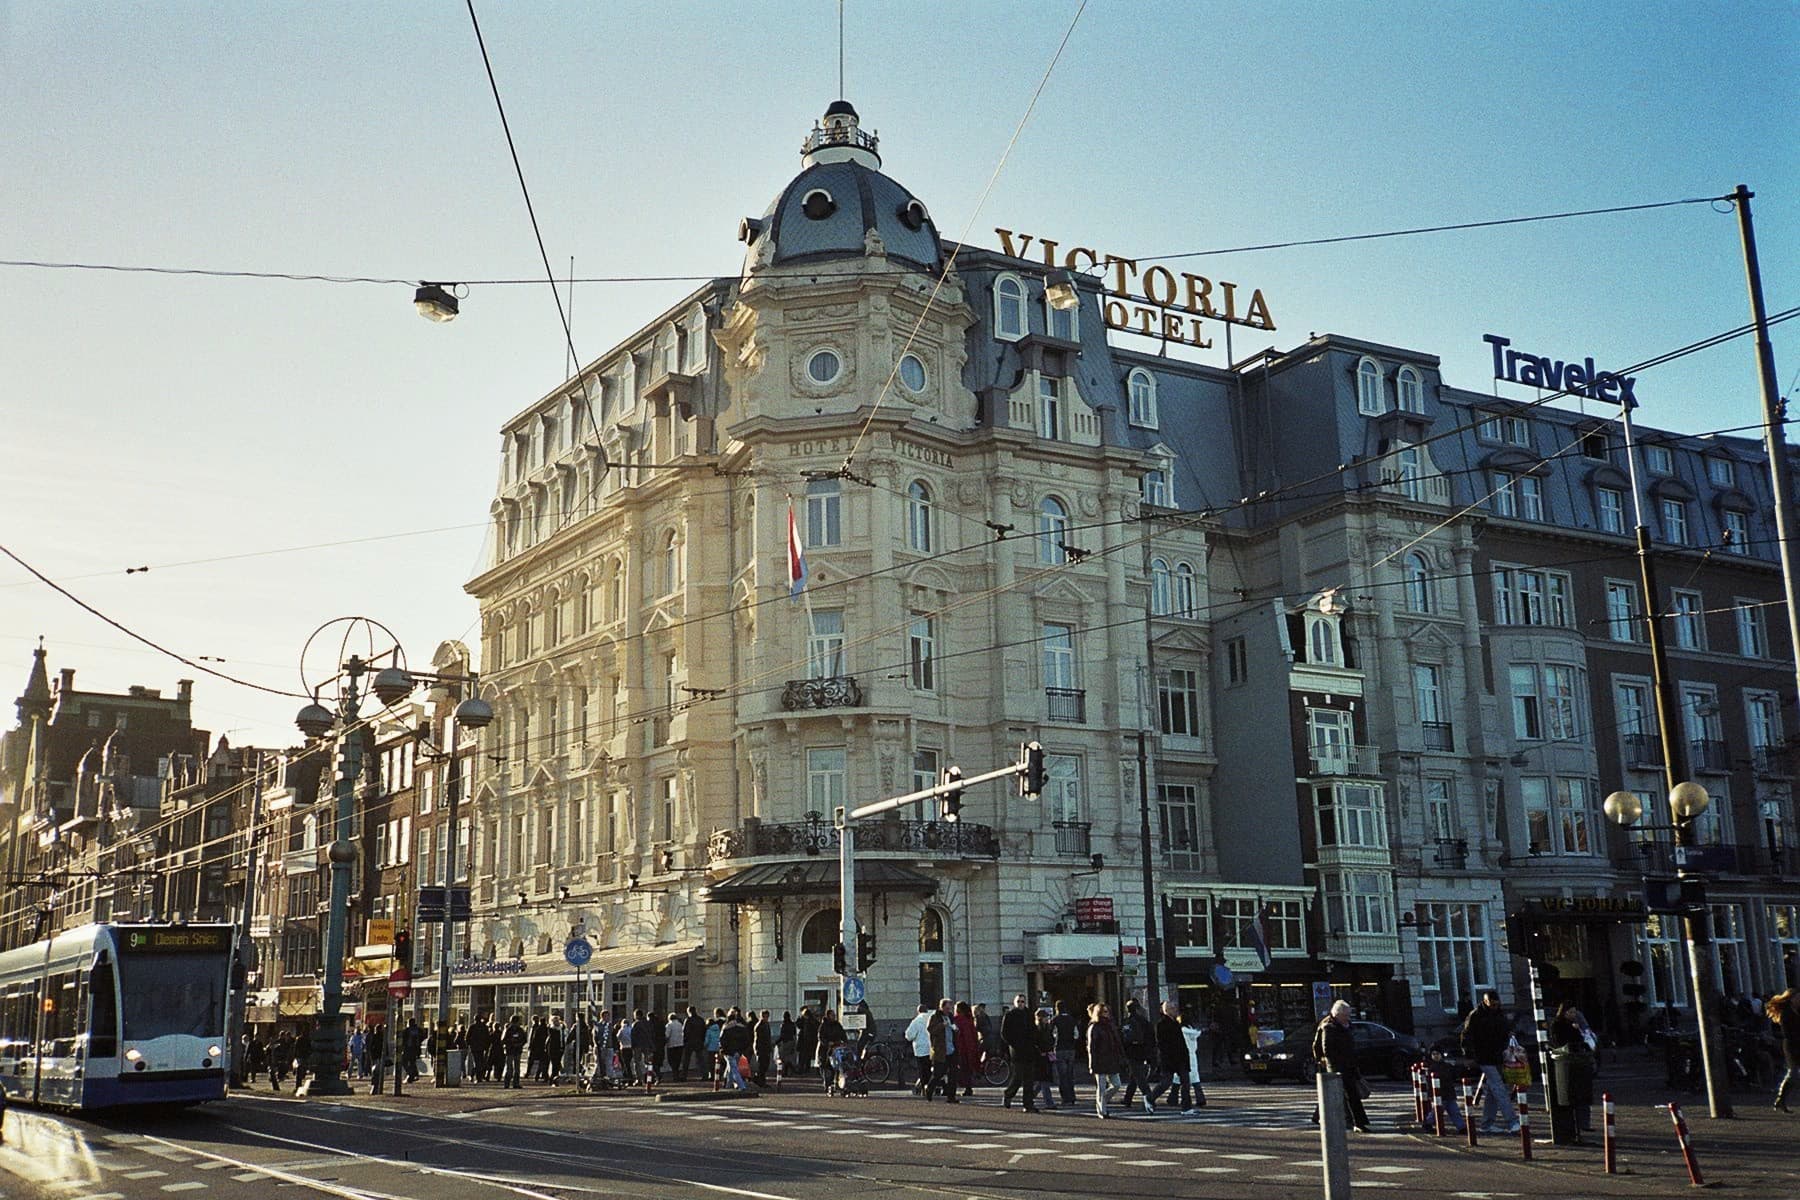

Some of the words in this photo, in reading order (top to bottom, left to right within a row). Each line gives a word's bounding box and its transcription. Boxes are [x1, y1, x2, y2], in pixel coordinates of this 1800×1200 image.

[994, 227, 1277, 331] VICTORIA
[1104, 300, 1213, 349] OTEL
[1482, 333, 1639, 407] Travelex
[789, 437, 855, 457] HOTEL
[890, 436, 955, 469] VICTORIA
[130, 932, 137, 948] 9
